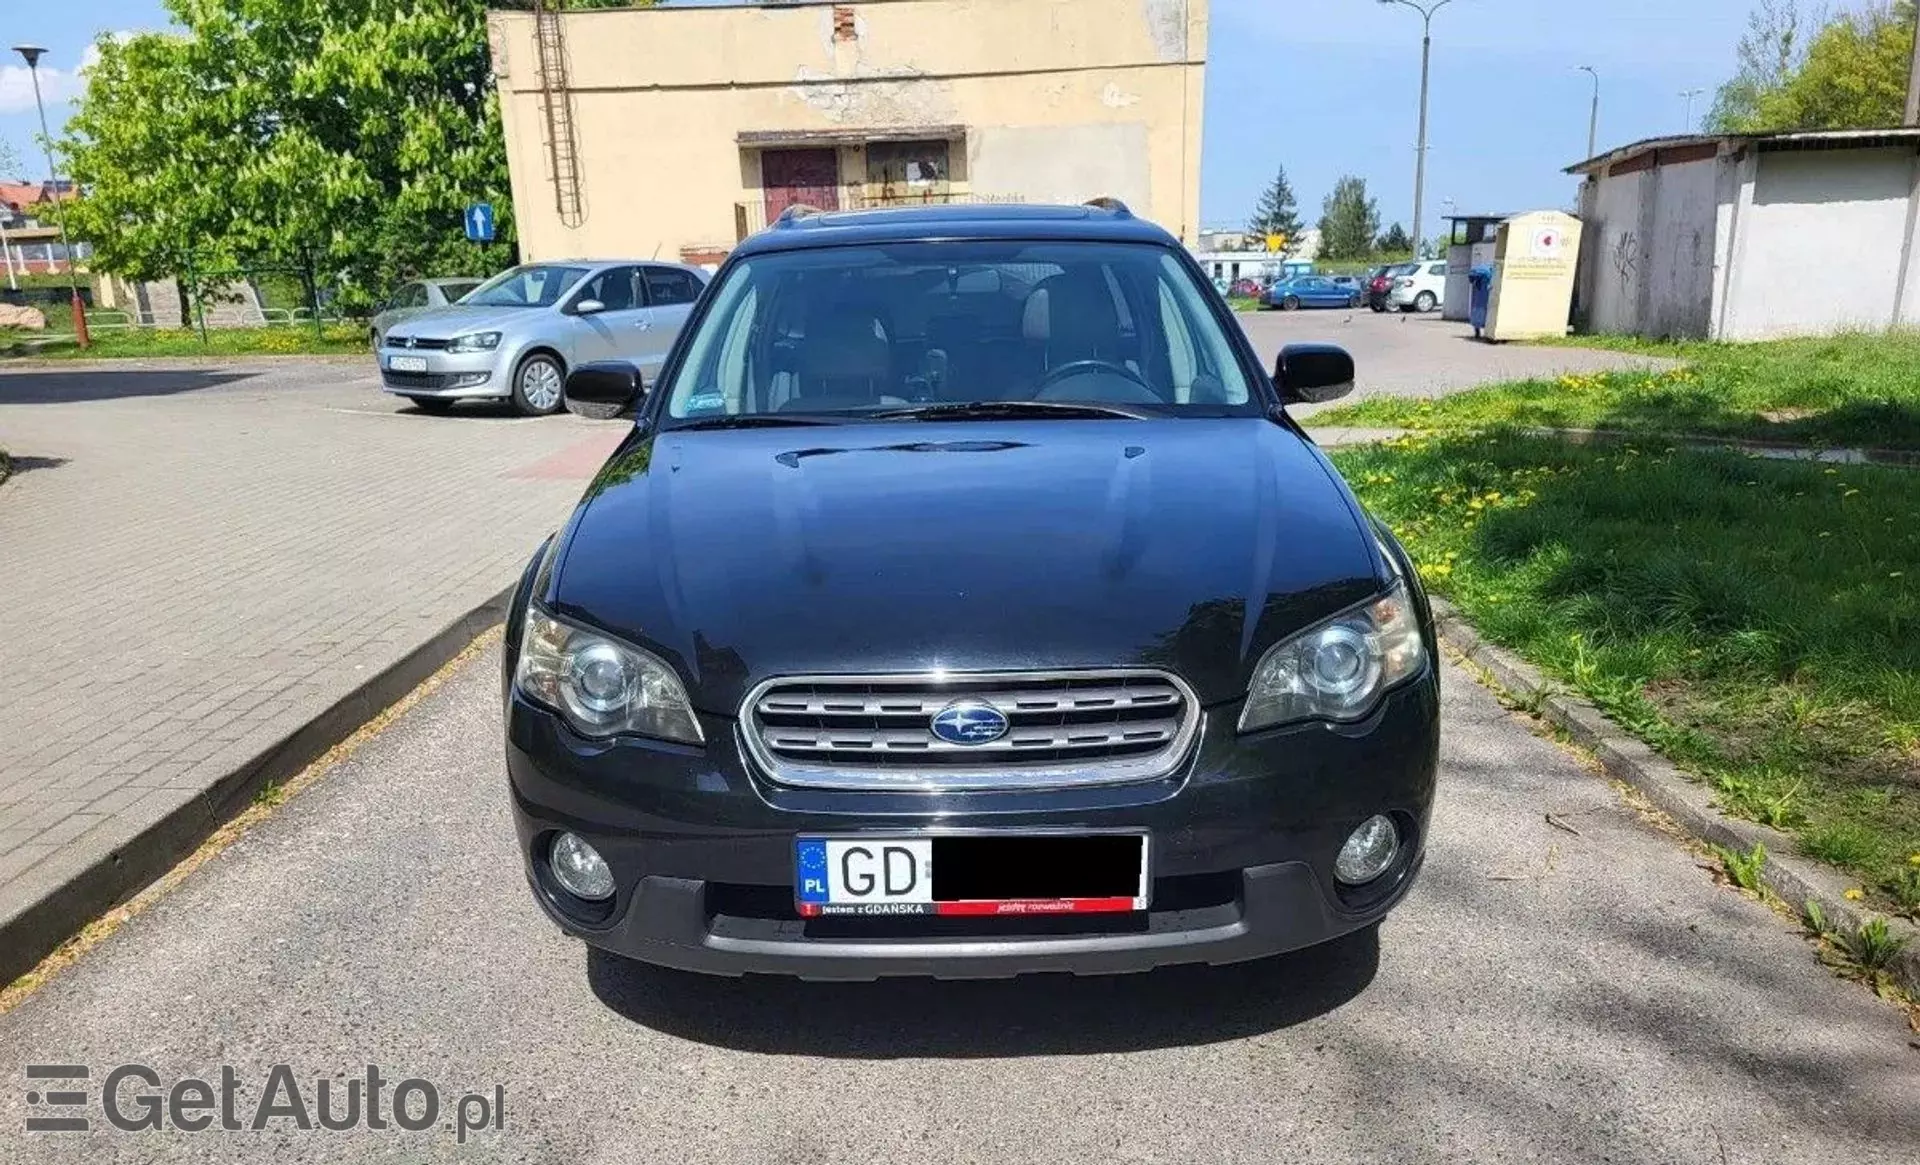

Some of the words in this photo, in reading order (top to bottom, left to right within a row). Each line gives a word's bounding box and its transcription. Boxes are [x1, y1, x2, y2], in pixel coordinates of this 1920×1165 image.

[842, 846, 917, 896] GD
[803, 879, 825, 893] PL
[865, 902, 925, 914] GDAŃSKA
